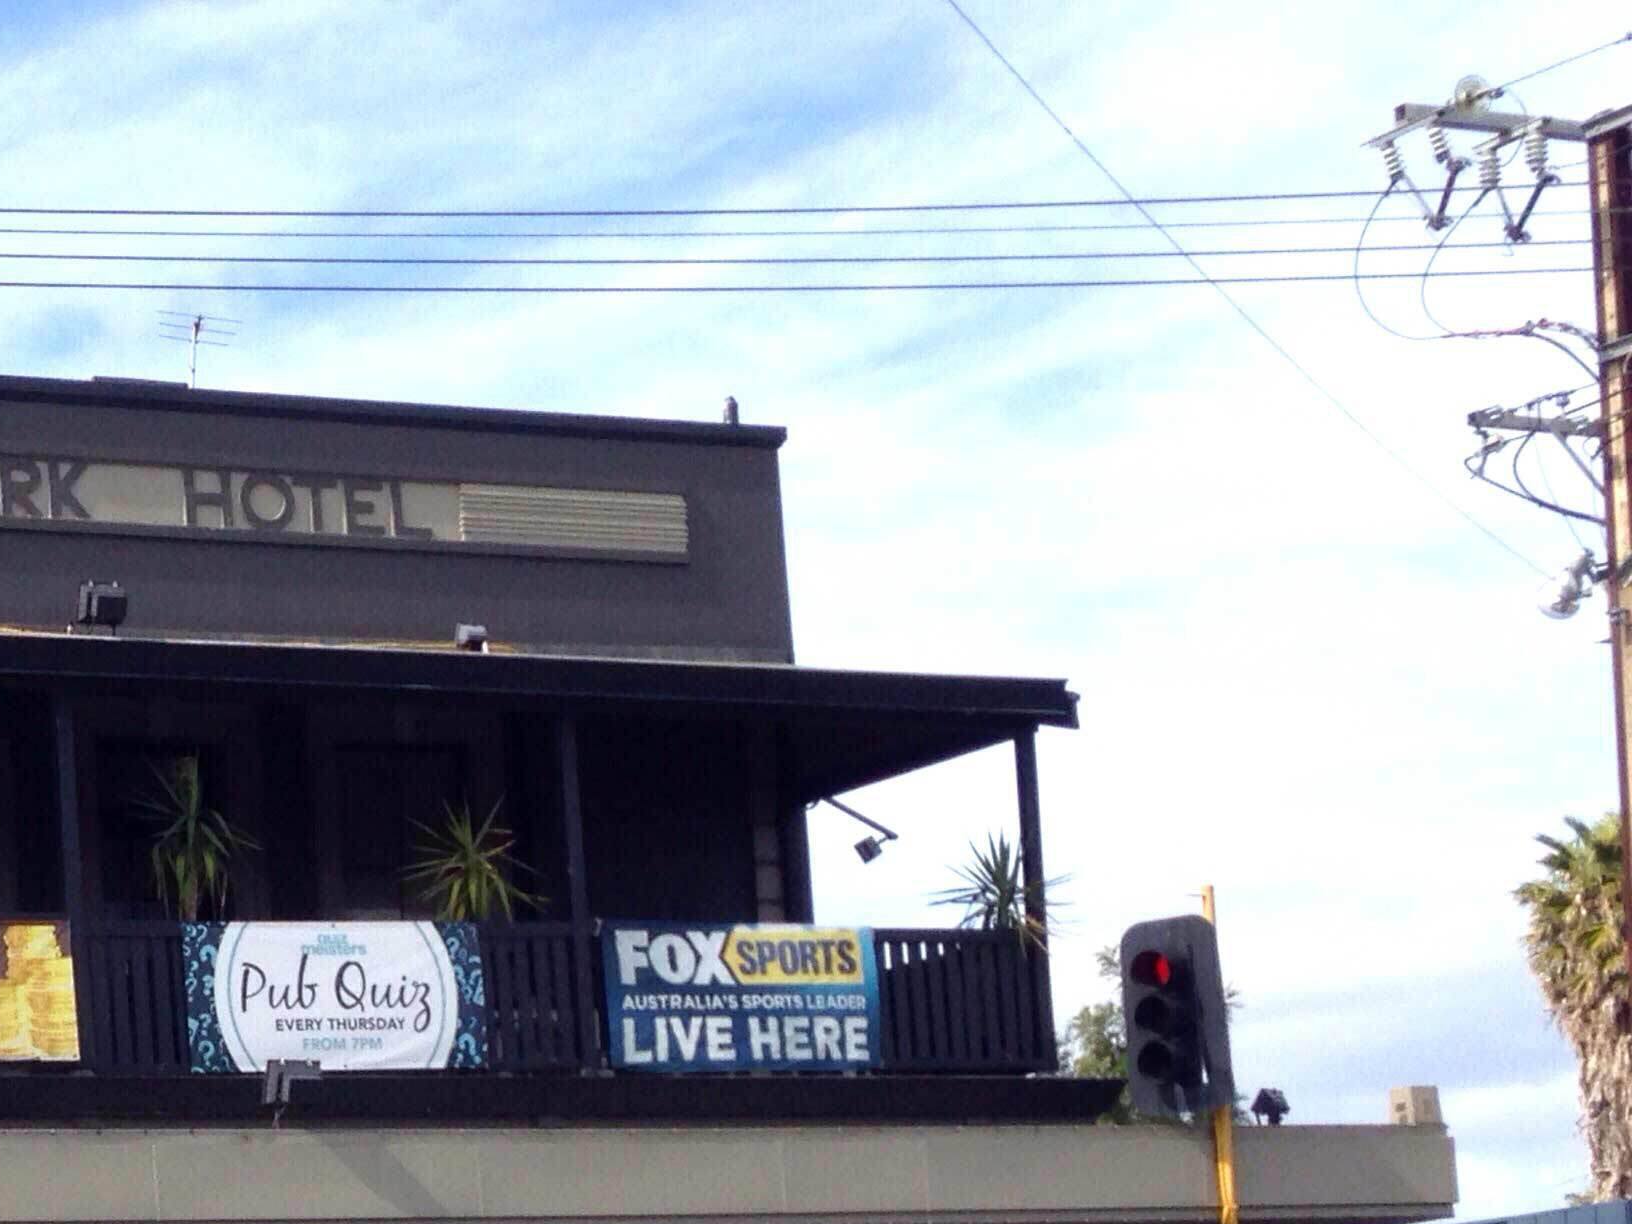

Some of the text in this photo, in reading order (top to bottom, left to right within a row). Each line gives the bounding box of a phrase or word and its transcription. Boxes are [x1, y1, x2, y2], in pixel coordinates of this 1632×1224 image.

[180, 466, 433, 542] HOTEL
[615, 929, 857, 986] FOX SPORTS
[240, 953, 432, 1034] Pub Quiz
[622, 993, 866, 1010] AUSTRALIA'S SPORTS LEADER
[275, 1017, 405, 1032] EVERY THURSDAY
[303, 1037, 383, 1050] FROM 7PM
[622, 1016, 870, 1064] LIVE HERE
